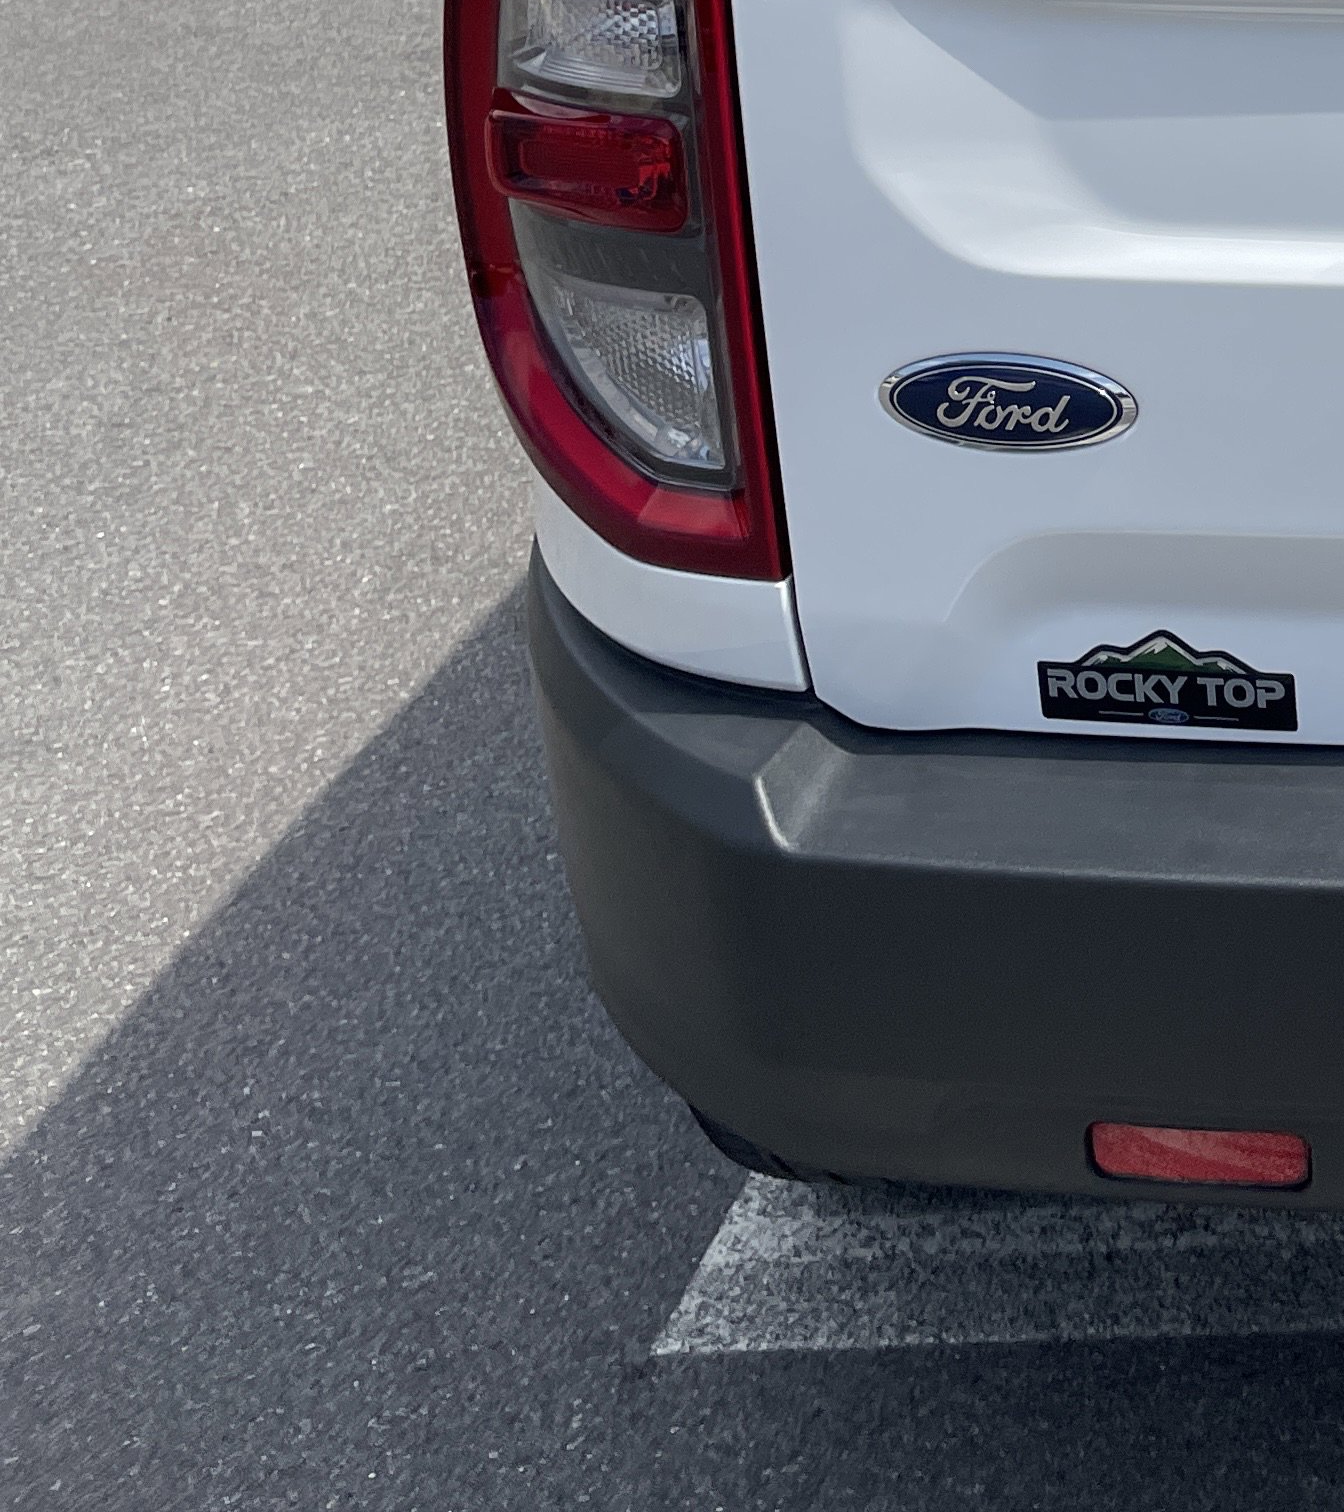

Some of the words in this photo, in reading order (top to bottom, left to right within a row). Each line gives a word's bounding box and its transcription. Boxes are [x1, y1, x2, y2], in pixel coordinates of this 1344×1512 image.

[936, 375, 1070, 433] Ford
[1046, 668, 1187, 705] ROCKY
[1197, 677, 1285, 709] TOP
